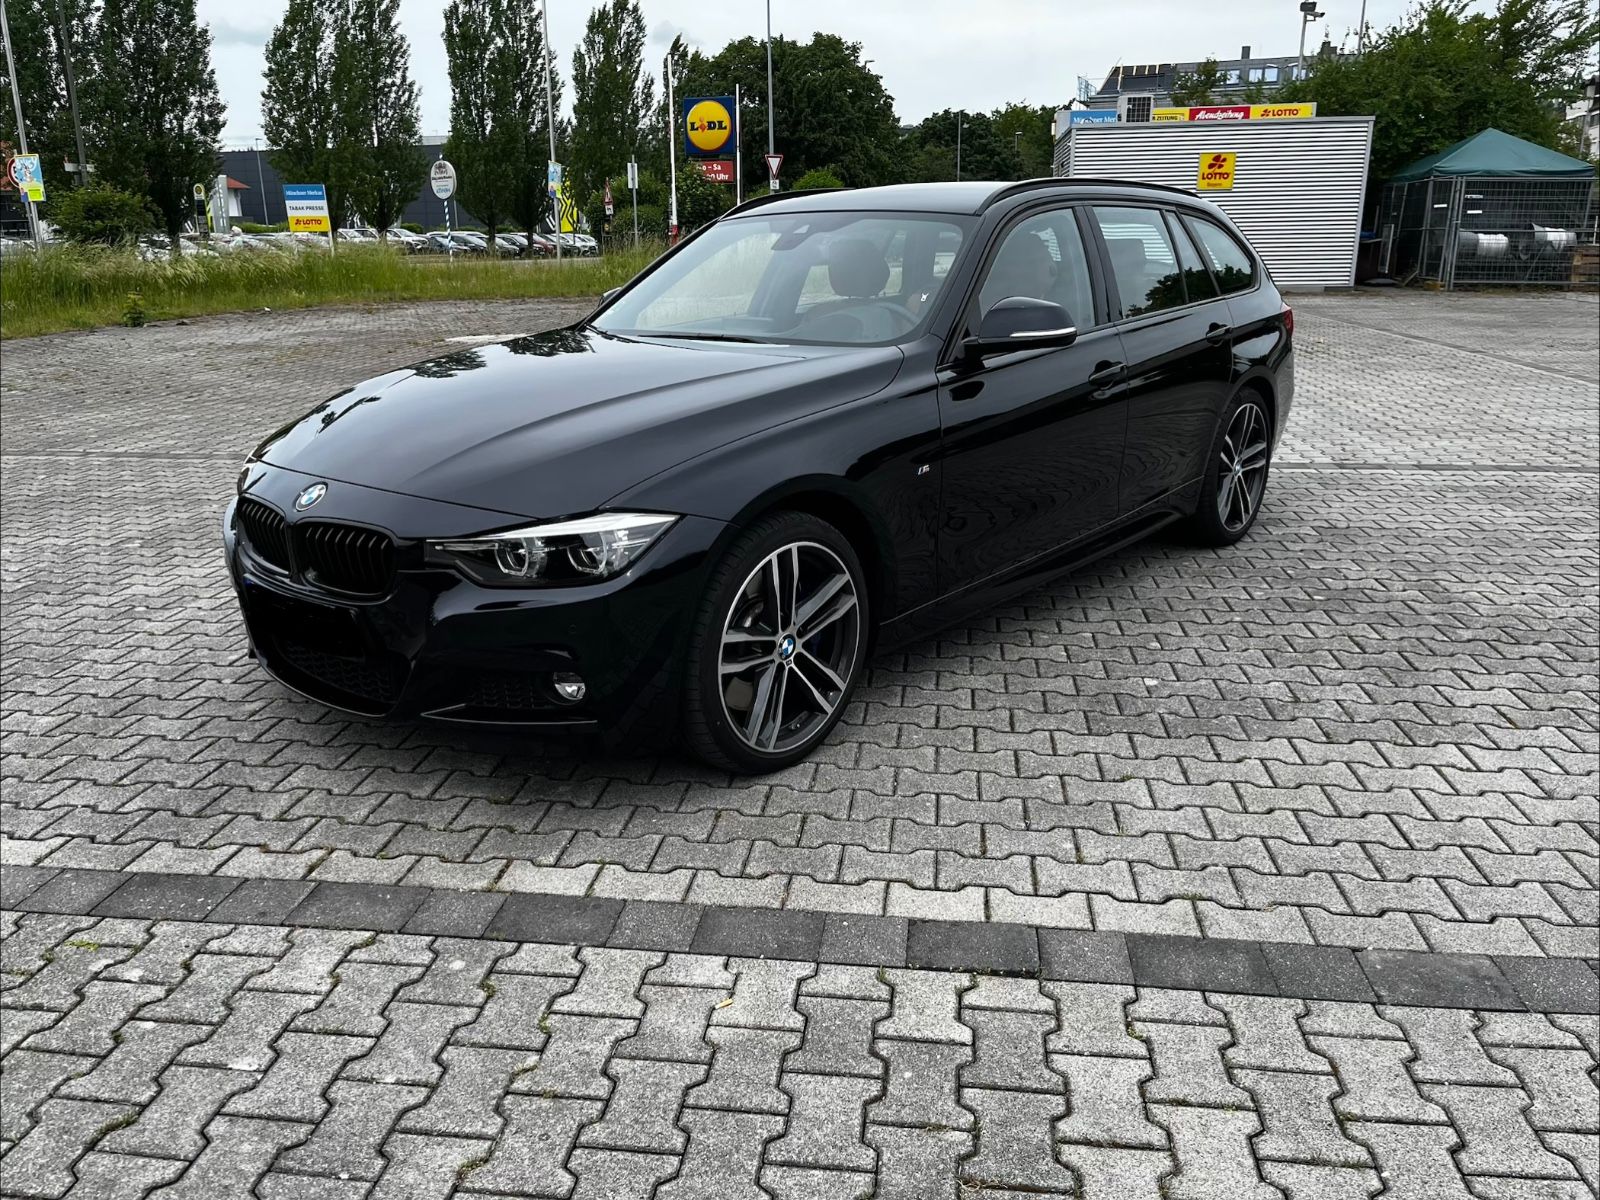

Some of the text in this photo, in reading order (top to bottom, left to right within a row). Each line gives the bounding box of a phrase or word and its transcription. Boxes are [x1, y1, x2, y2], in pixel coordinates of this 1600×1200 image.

[1272, 109, 1299, 117] LOTTO
[713, 163, 722, 171] Sa
[1202, 172, 1230, 180] LOTTO
